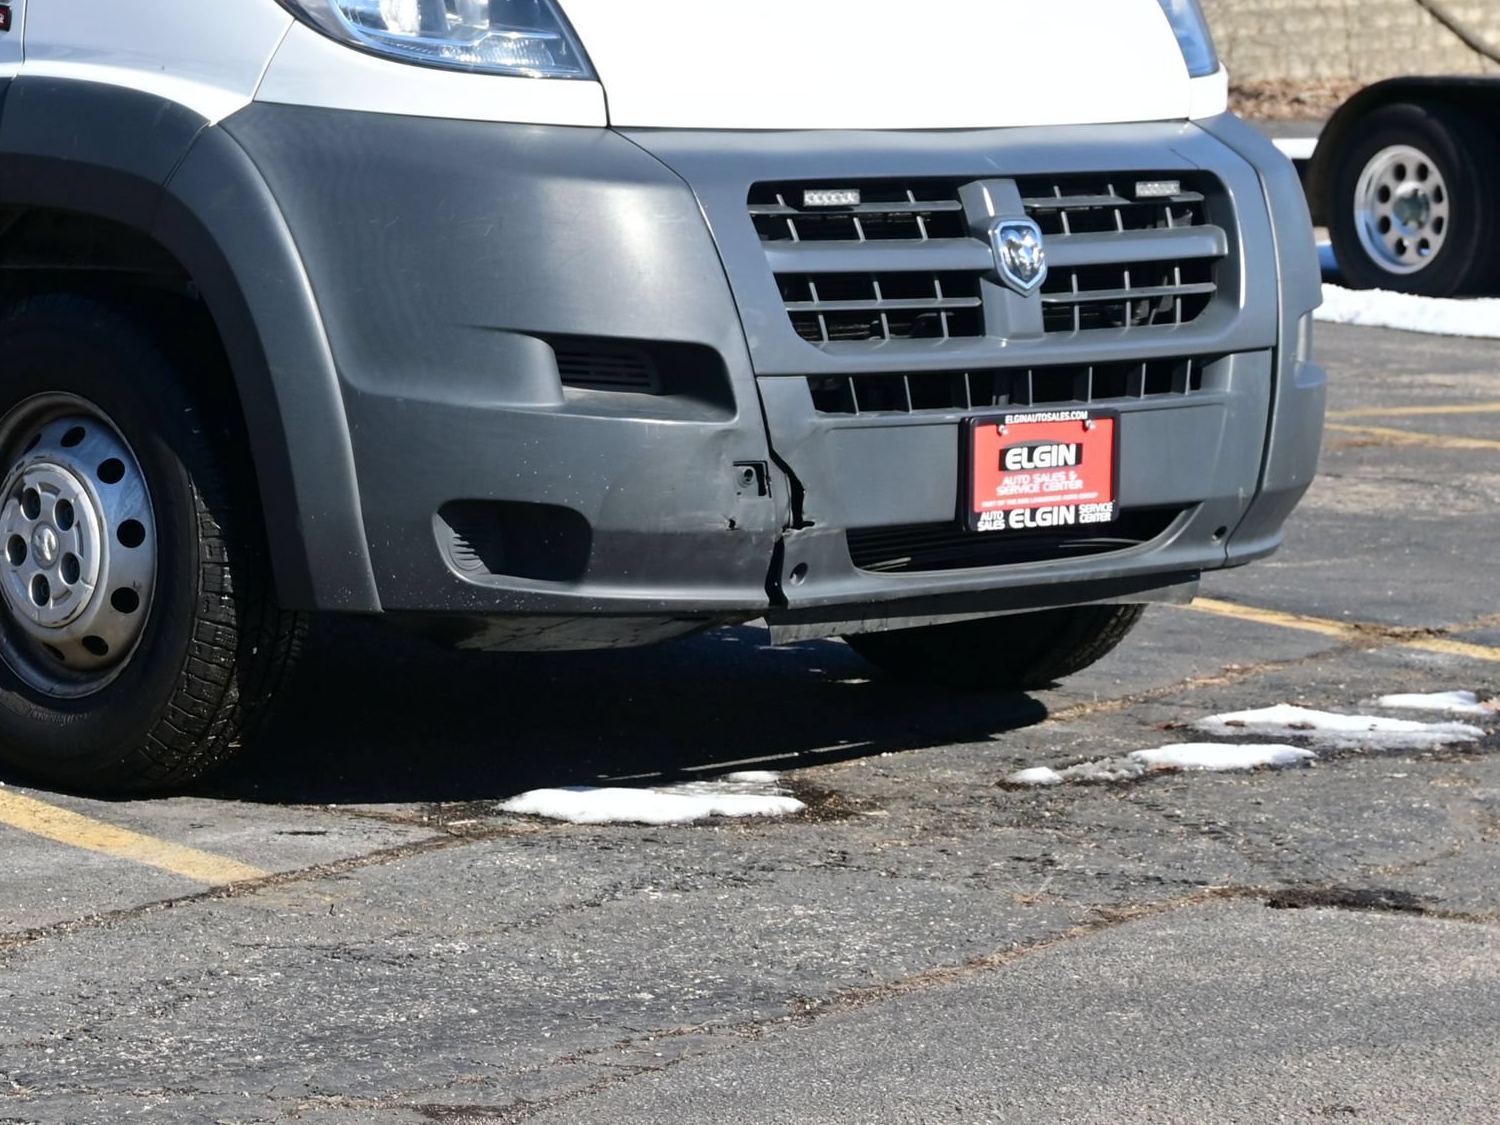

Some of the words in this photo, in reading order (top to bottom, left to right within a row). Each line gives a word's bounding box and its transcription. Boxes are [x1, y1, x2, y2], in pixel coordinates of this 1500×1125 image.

[1005, 410, 1088, 424] ELGINAUTOSALES.COM
[1005, 443, 1077, 470] ELGIN
[1001, 475, 1030, 486] AUTO
[1032, 472, 1066, 483] SALES
[996, 483, 1040, 496] SERVICE
[1042, 480, 1083, 492] CENTER
[980, 510, 1004, 521] AUTO
[1078, 502, 1113, 515] SERVICE
[1008, 505, 1075, 529] ELGIN
[1079, 512, 1112, 523] CENTER
[977, 520, 1005, 531] SALES
